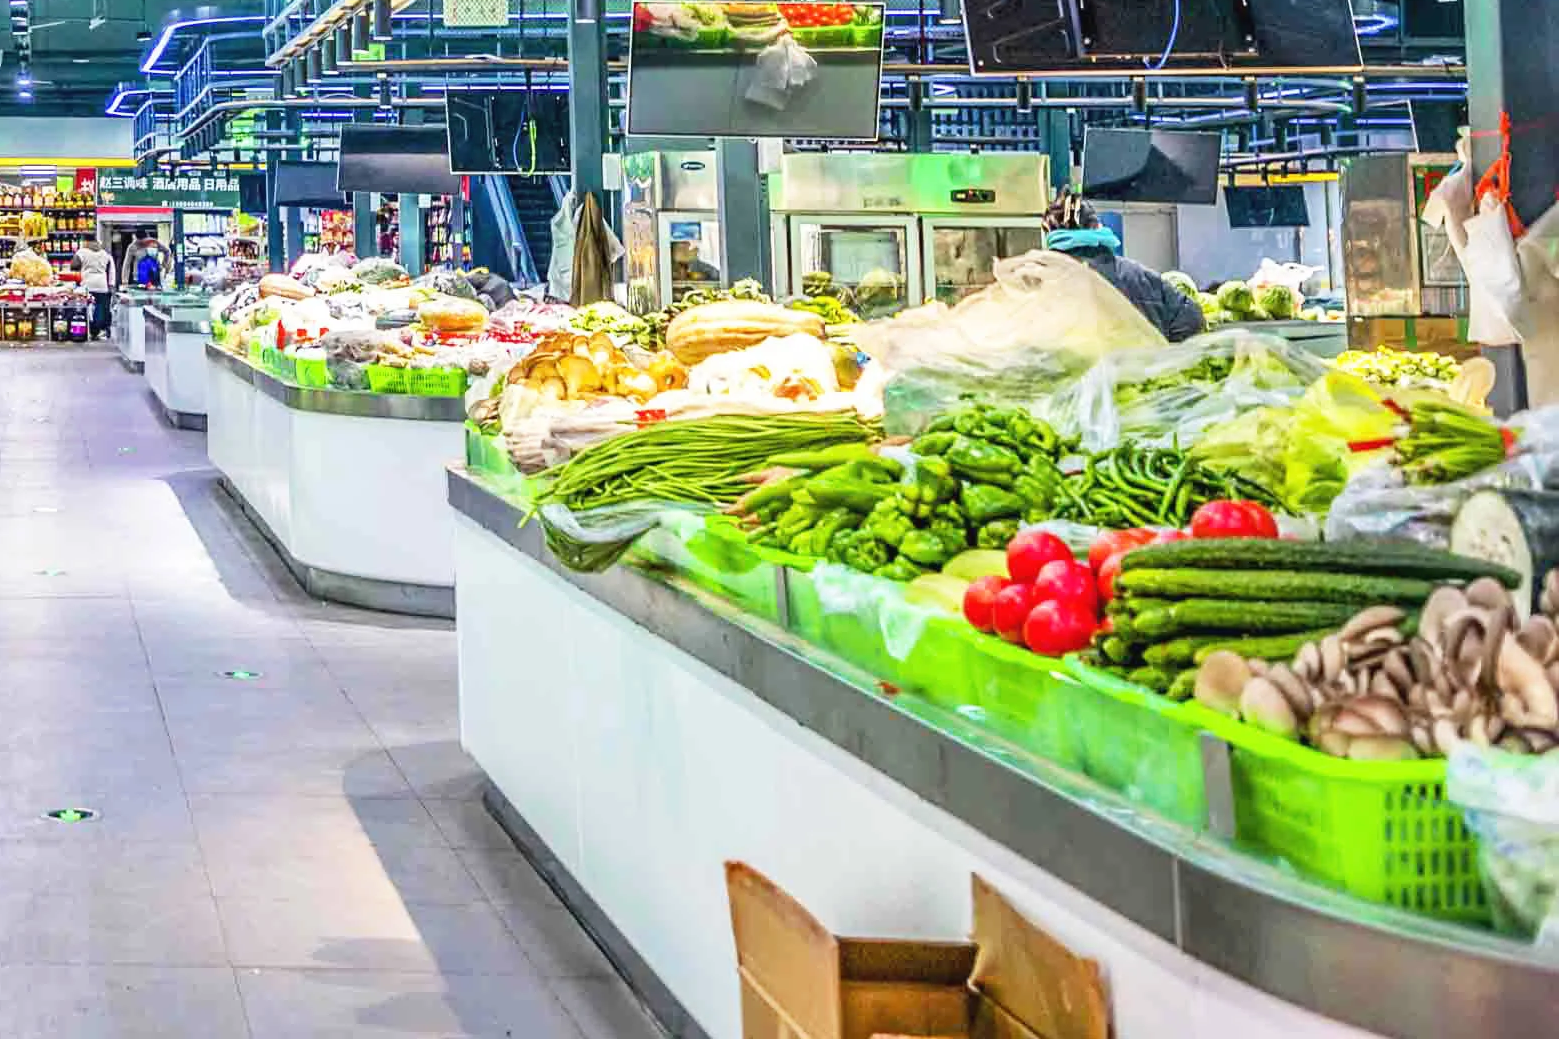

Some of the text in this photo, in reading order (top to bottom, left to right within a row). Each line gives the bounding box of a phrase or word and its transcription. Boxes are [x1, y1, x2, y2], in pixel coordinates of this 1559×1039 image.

[153, 177, 201, 191] 酒店用品
[204, 178, 240, 191] 日用品
